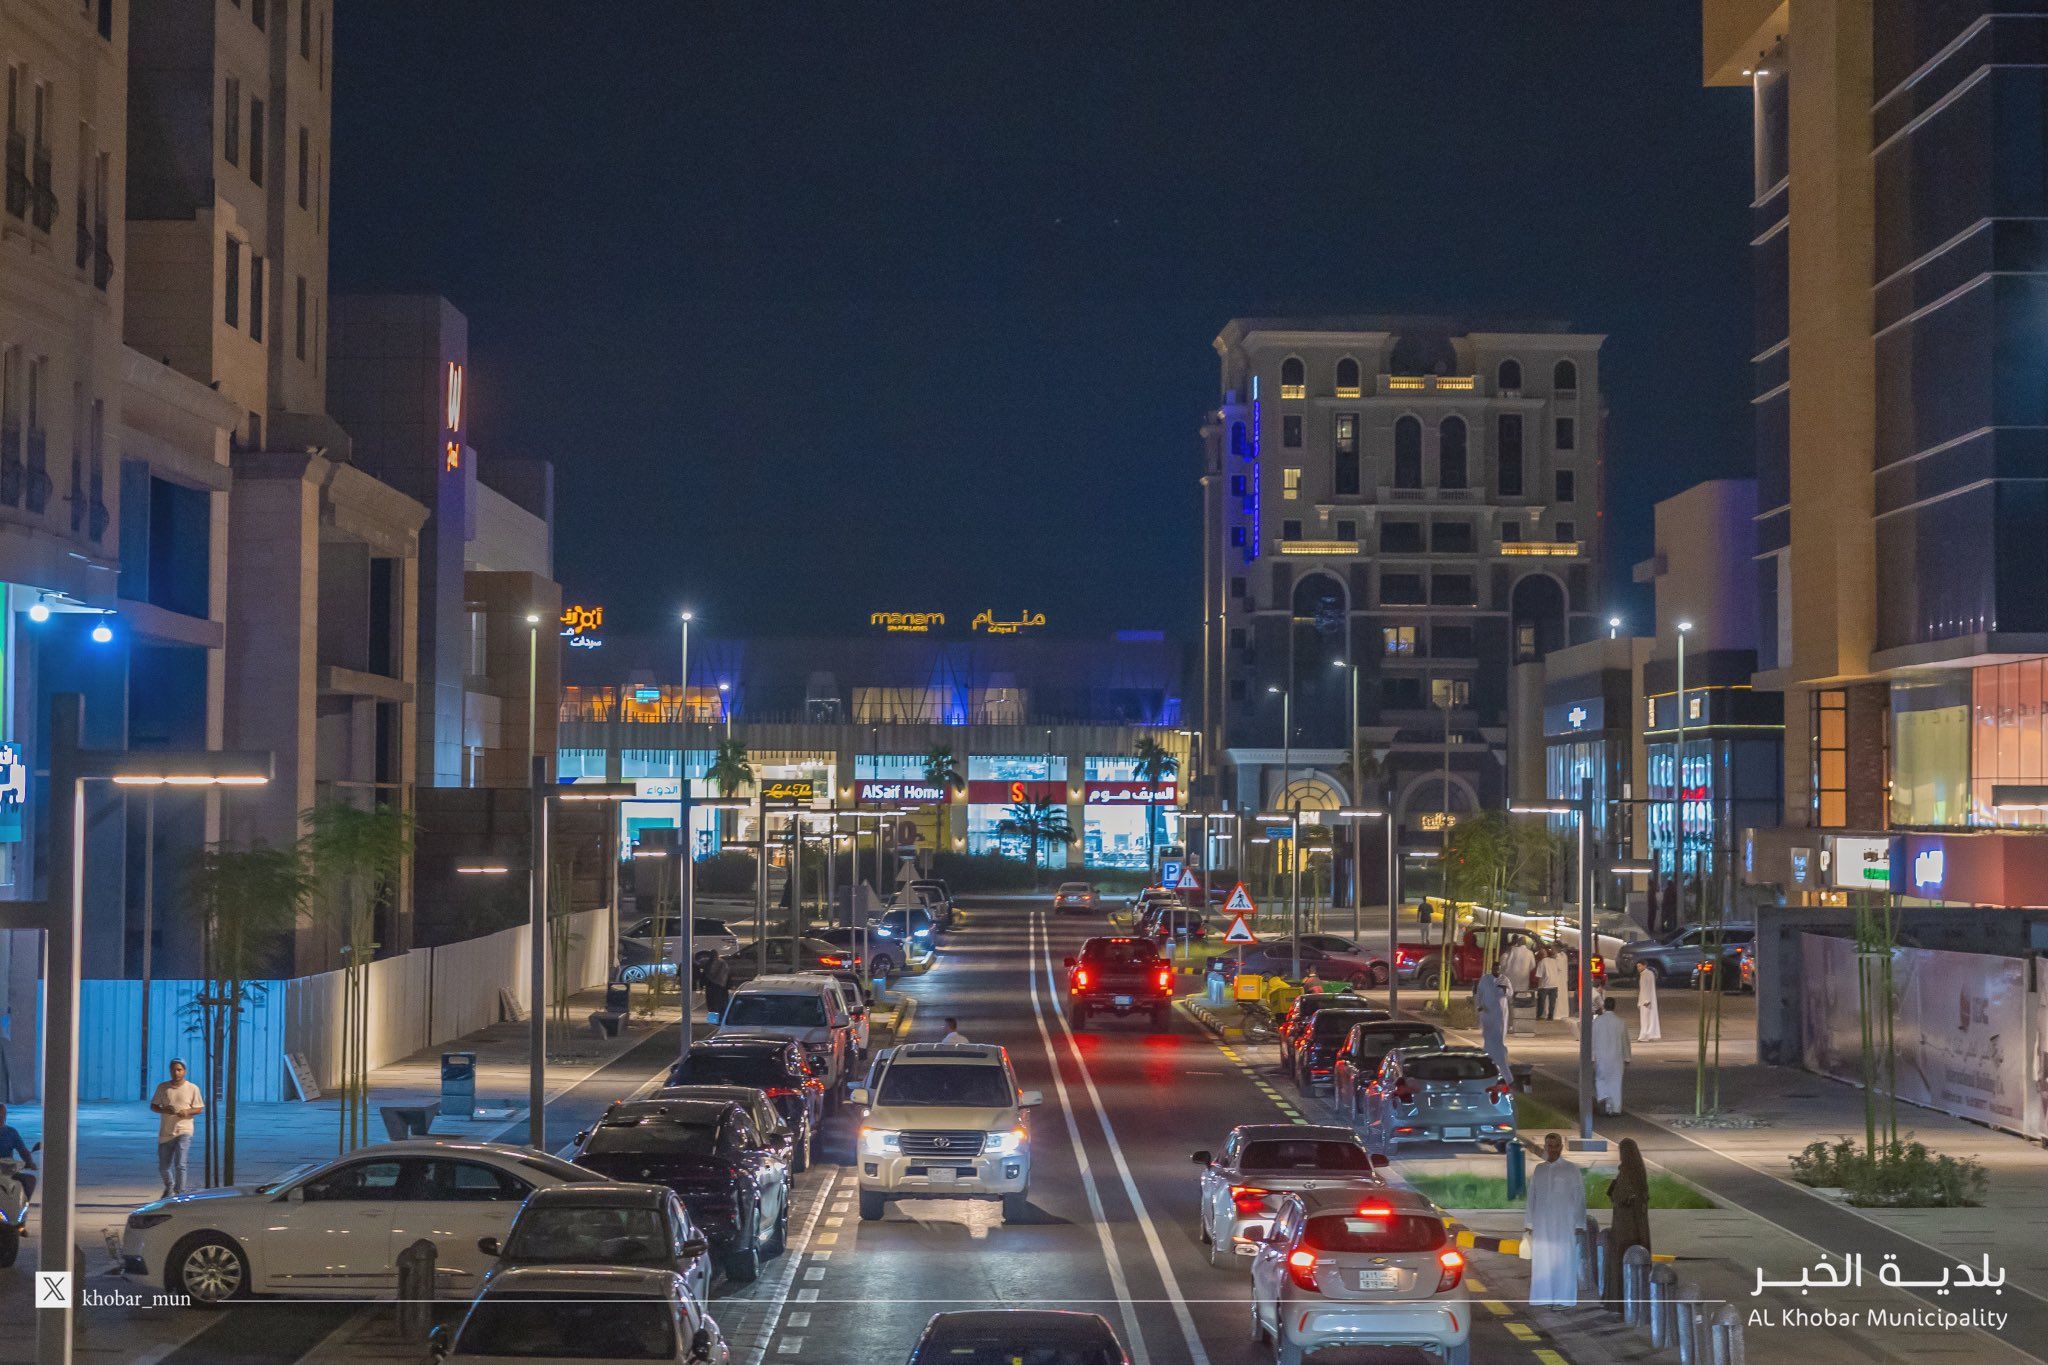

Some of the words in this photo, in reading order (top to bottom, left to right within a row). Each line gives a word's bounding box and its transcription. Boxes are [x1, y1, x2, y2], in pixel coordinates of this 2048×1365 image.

[870, 612, 945, 626] manam
[972, 608, 1046, 630] منام
[646, 784, 678, 796] الدواء
[862, 784, 900, 799] AlSaif
[1011, 781, 1025, 803] S
[1166, 864, 1178, 879] P
